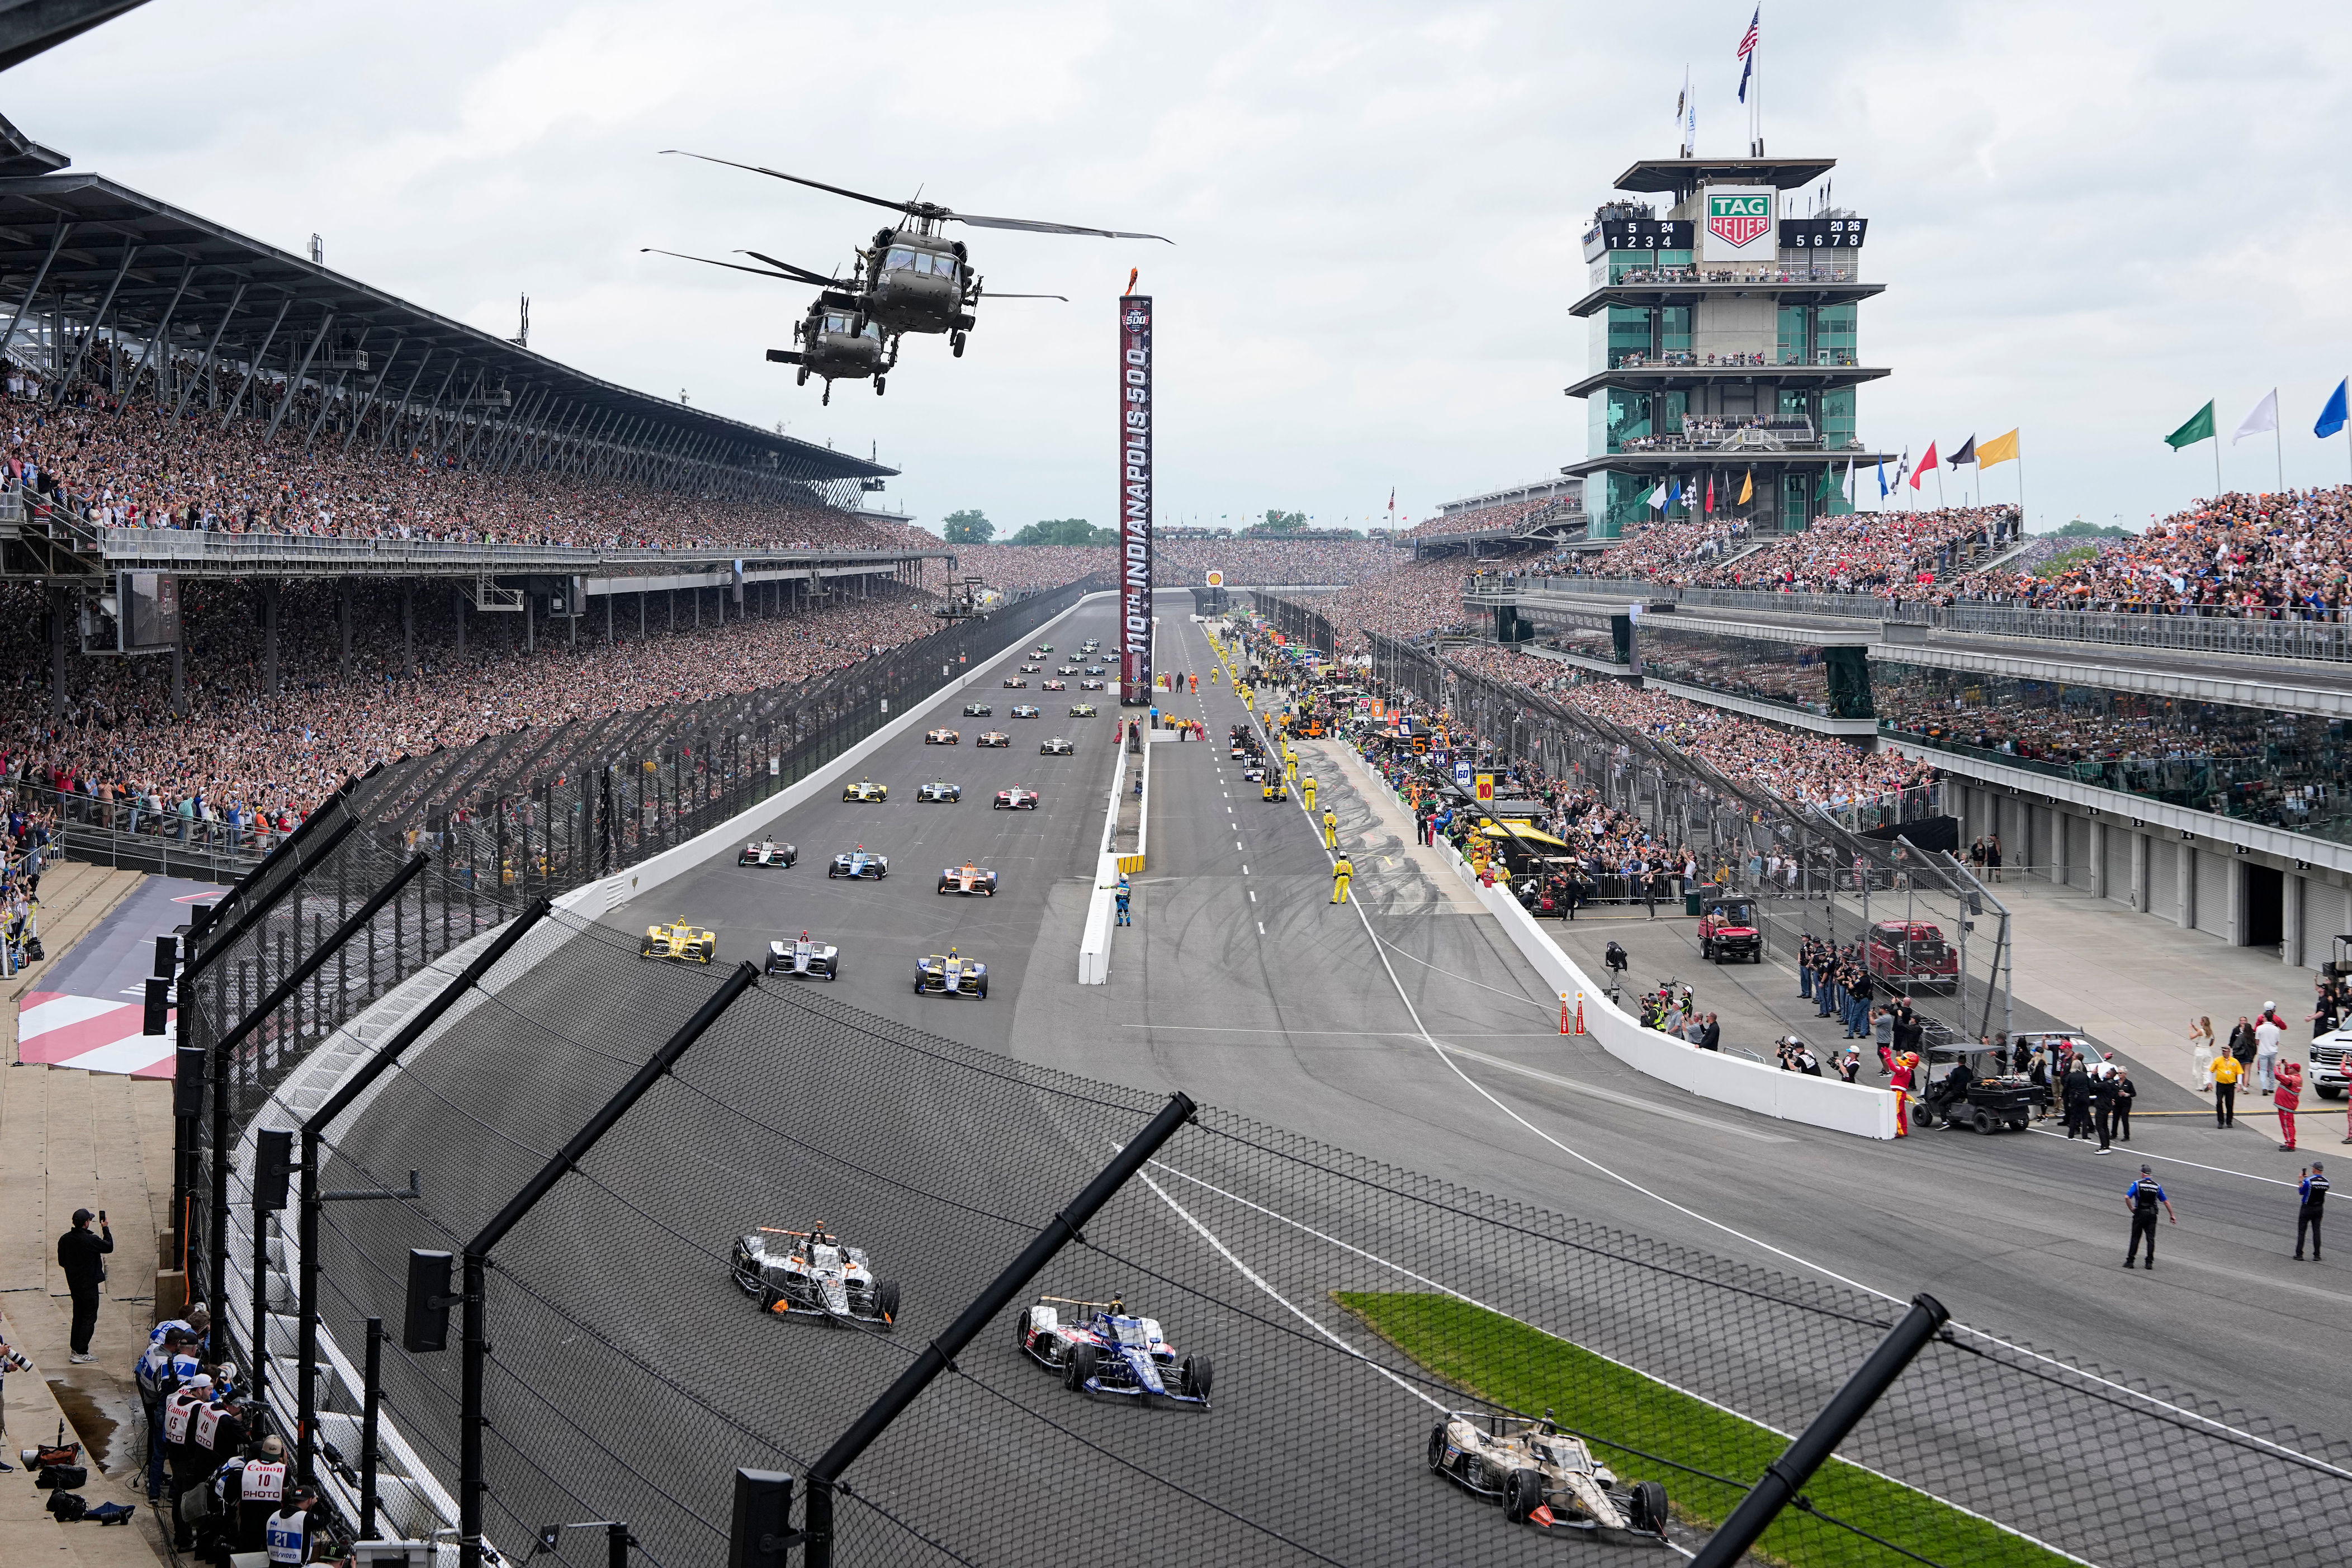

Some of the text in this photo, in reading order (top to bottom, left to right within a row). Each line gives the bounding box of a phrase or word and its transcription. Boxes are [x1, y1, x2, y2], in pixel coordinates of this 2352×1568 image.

[1715, 199, 1764, 215] TAG
[1628, 222, 1673, 233] 5 24
[1712, 219, 1766, 242] HEUER
[1830, 221, 1861, 231] 20 26
[1611, 236, 1617, 248] 1
[1627, 236, 1636, 248] 2
[1645, 236, 1654, 248] 3
[1662, 236, 1672, 248] 4
[1796, 234, 1858, 247] 5 6 7 8
[1125, 316, 1146, 324] 500
[1126, 349, 1146, 404] 500
[1126, 410, 1146, 588] INDIANAPOLIS
[1127, 594, 1146, 654] 110TH
[1374, 705, 1380, 716] 9
[1399, 724, 1411, 735] 8
[1412, 737, 1426, 755] 5
[1435, 754, 1446, 764] 14
[1457, 770, 1469, 779] 60
[1479, 784, 1492, 798] 10
[167, 1404, 188, 1418] Canon
[201, 1405, 217, 1424] Canon
[200, 1420, 209, 1434] 49
[247, 1464, 283, 1473] Canon
[258, 1474, 271, 1487] 10
[275, 1532, 288, 1547] 21
